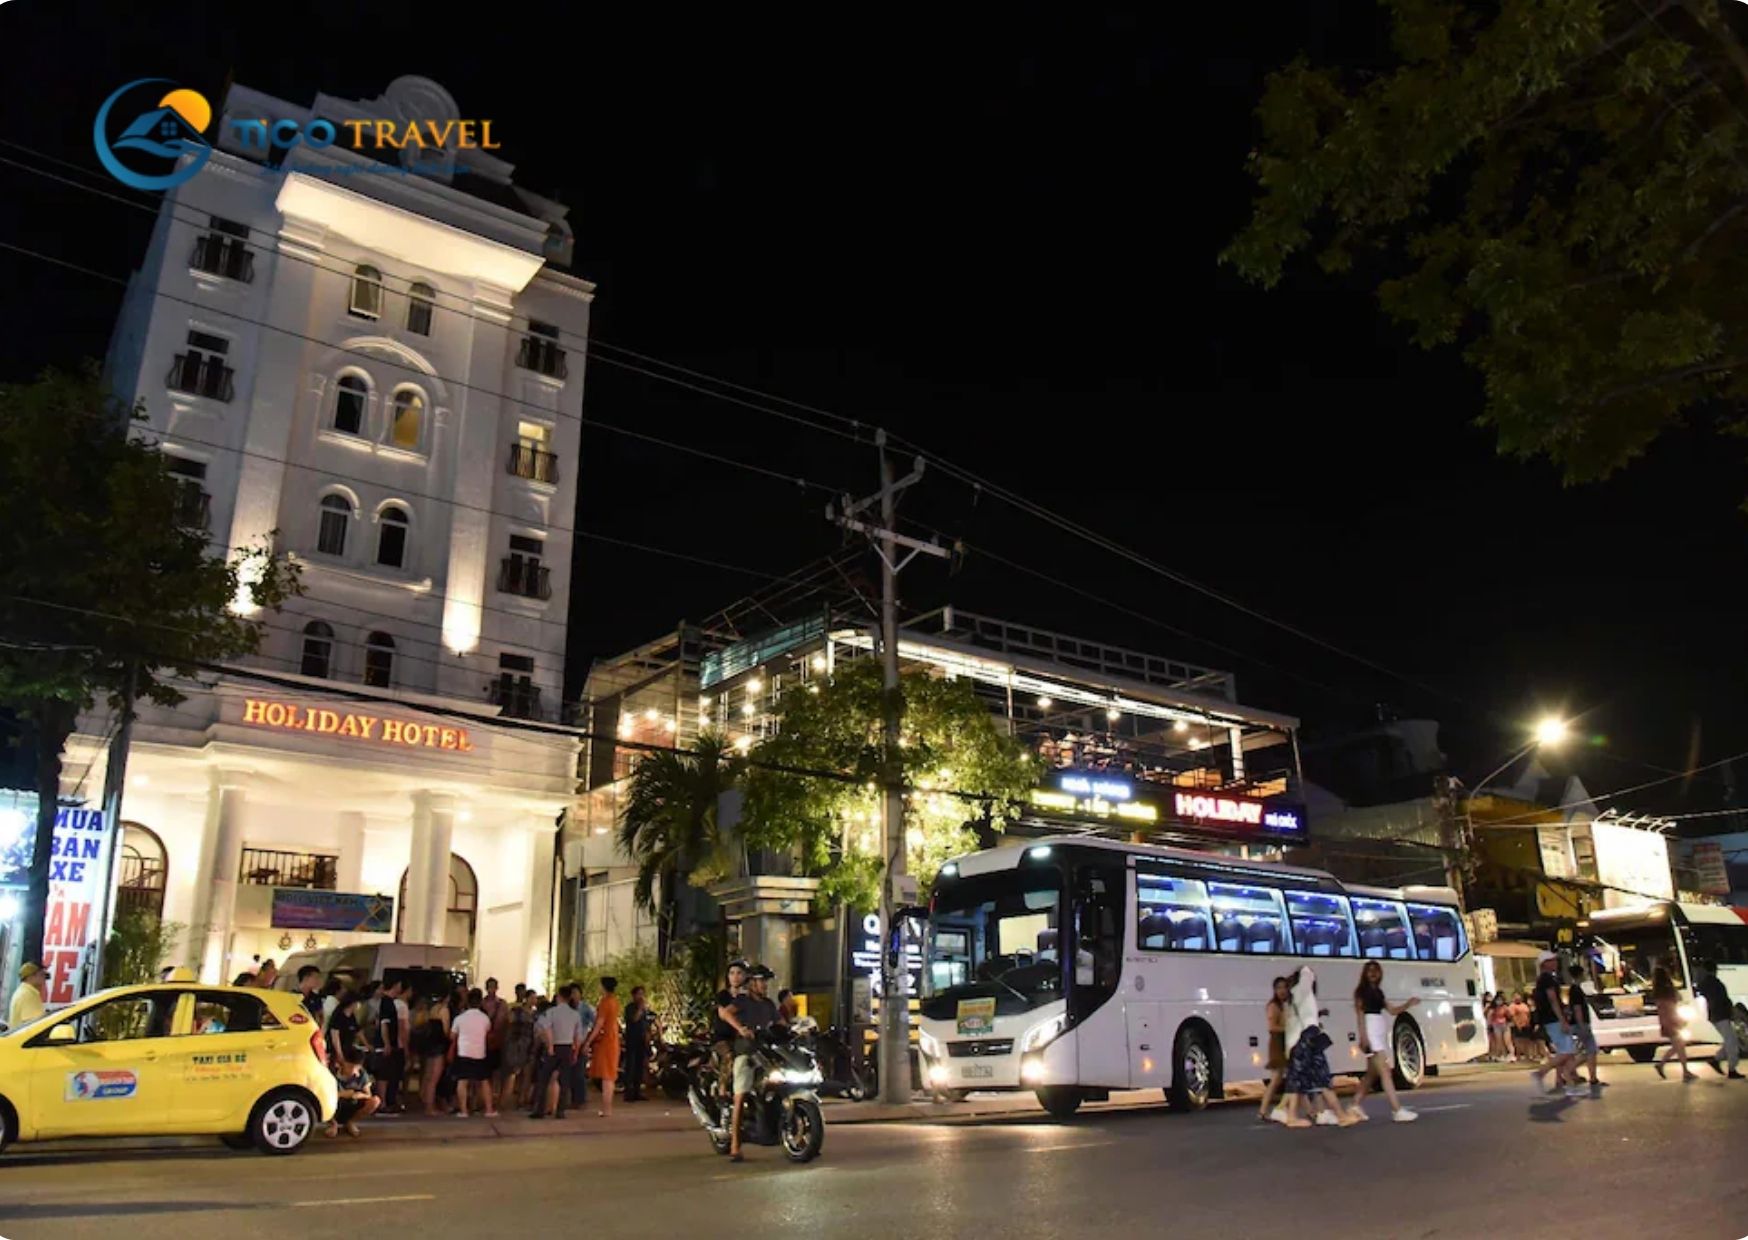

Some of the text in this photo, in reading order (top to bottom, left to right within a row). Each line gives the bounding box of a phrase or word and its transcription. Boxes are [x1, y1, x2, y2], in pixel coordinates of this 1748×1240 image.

[243, 699, 475, 751] HOLIDAY HOTEL
[1175, 793, 1263, 824] HOLIDAY
[49, 861, 85, 882] XE
